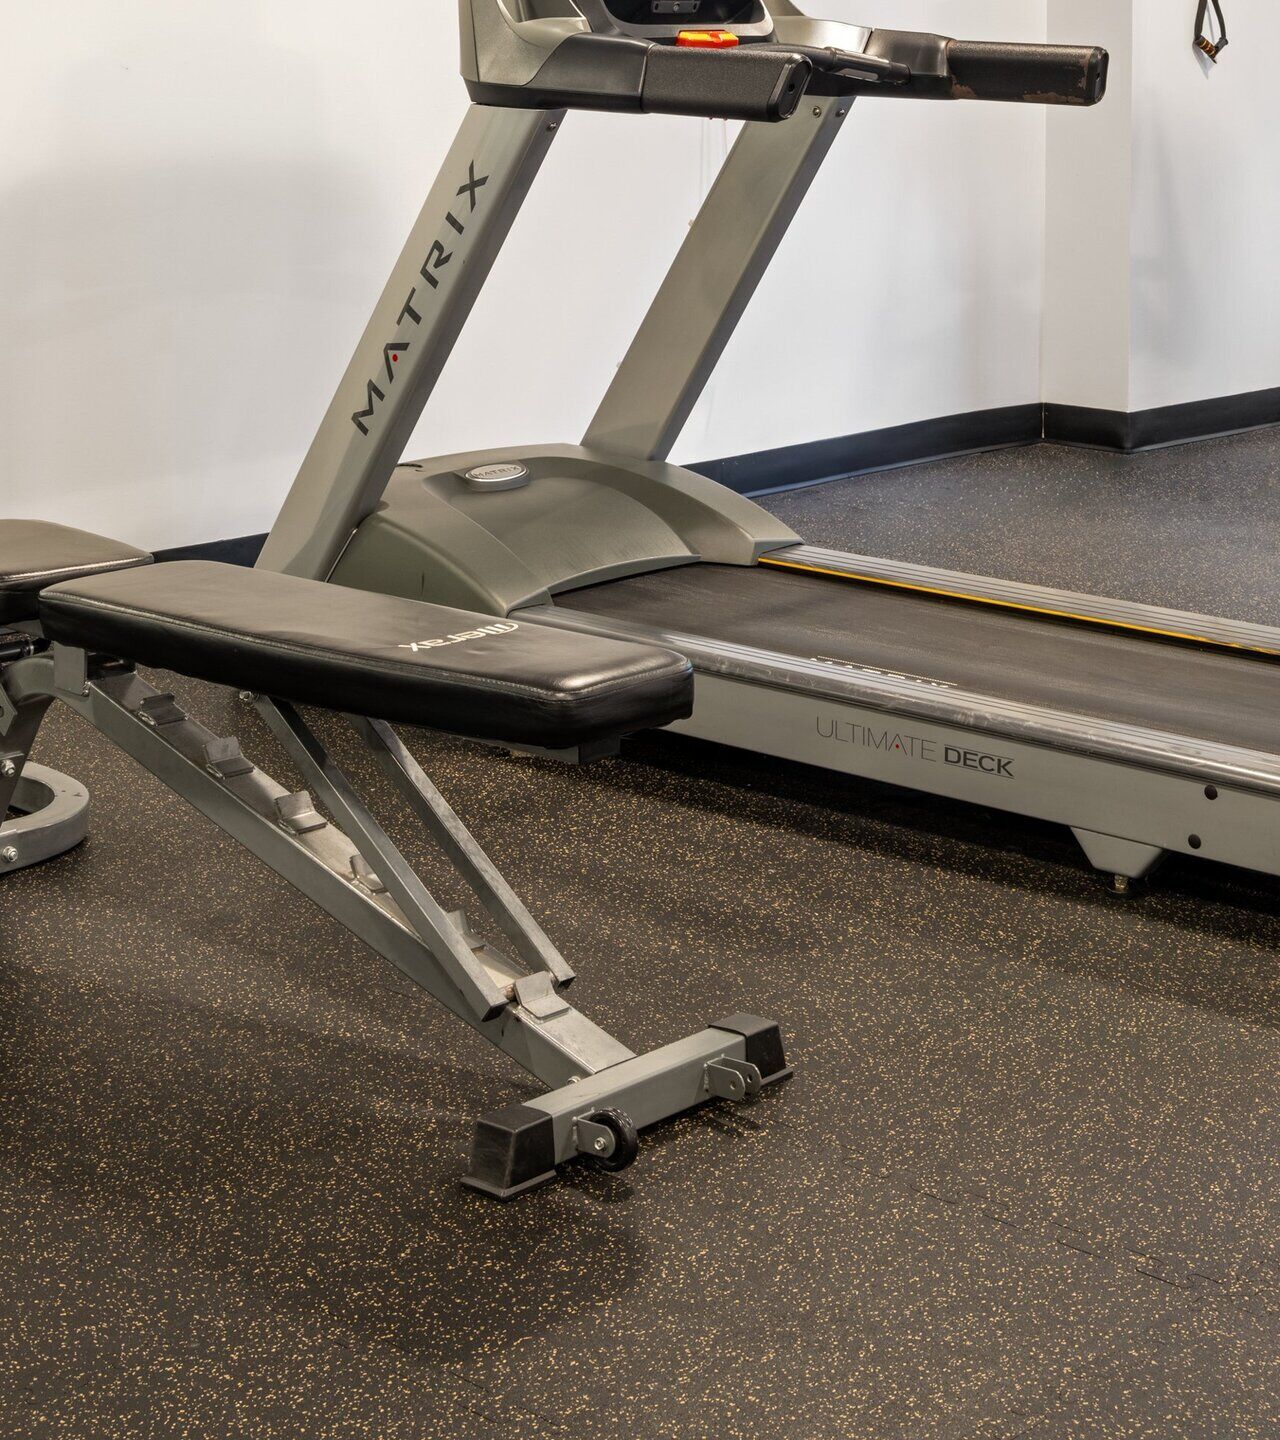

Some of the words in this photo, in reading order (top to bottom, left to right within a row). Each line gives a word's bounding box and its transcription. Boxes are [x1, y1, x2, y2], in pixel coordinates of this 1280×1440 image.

[351, 159, 490, 437] MATRIX
[473, 465, 520, 479] MATRIX
[816, 716, 937, 762] ULTIMATE
[943, 745, 1015, 778] DECK
